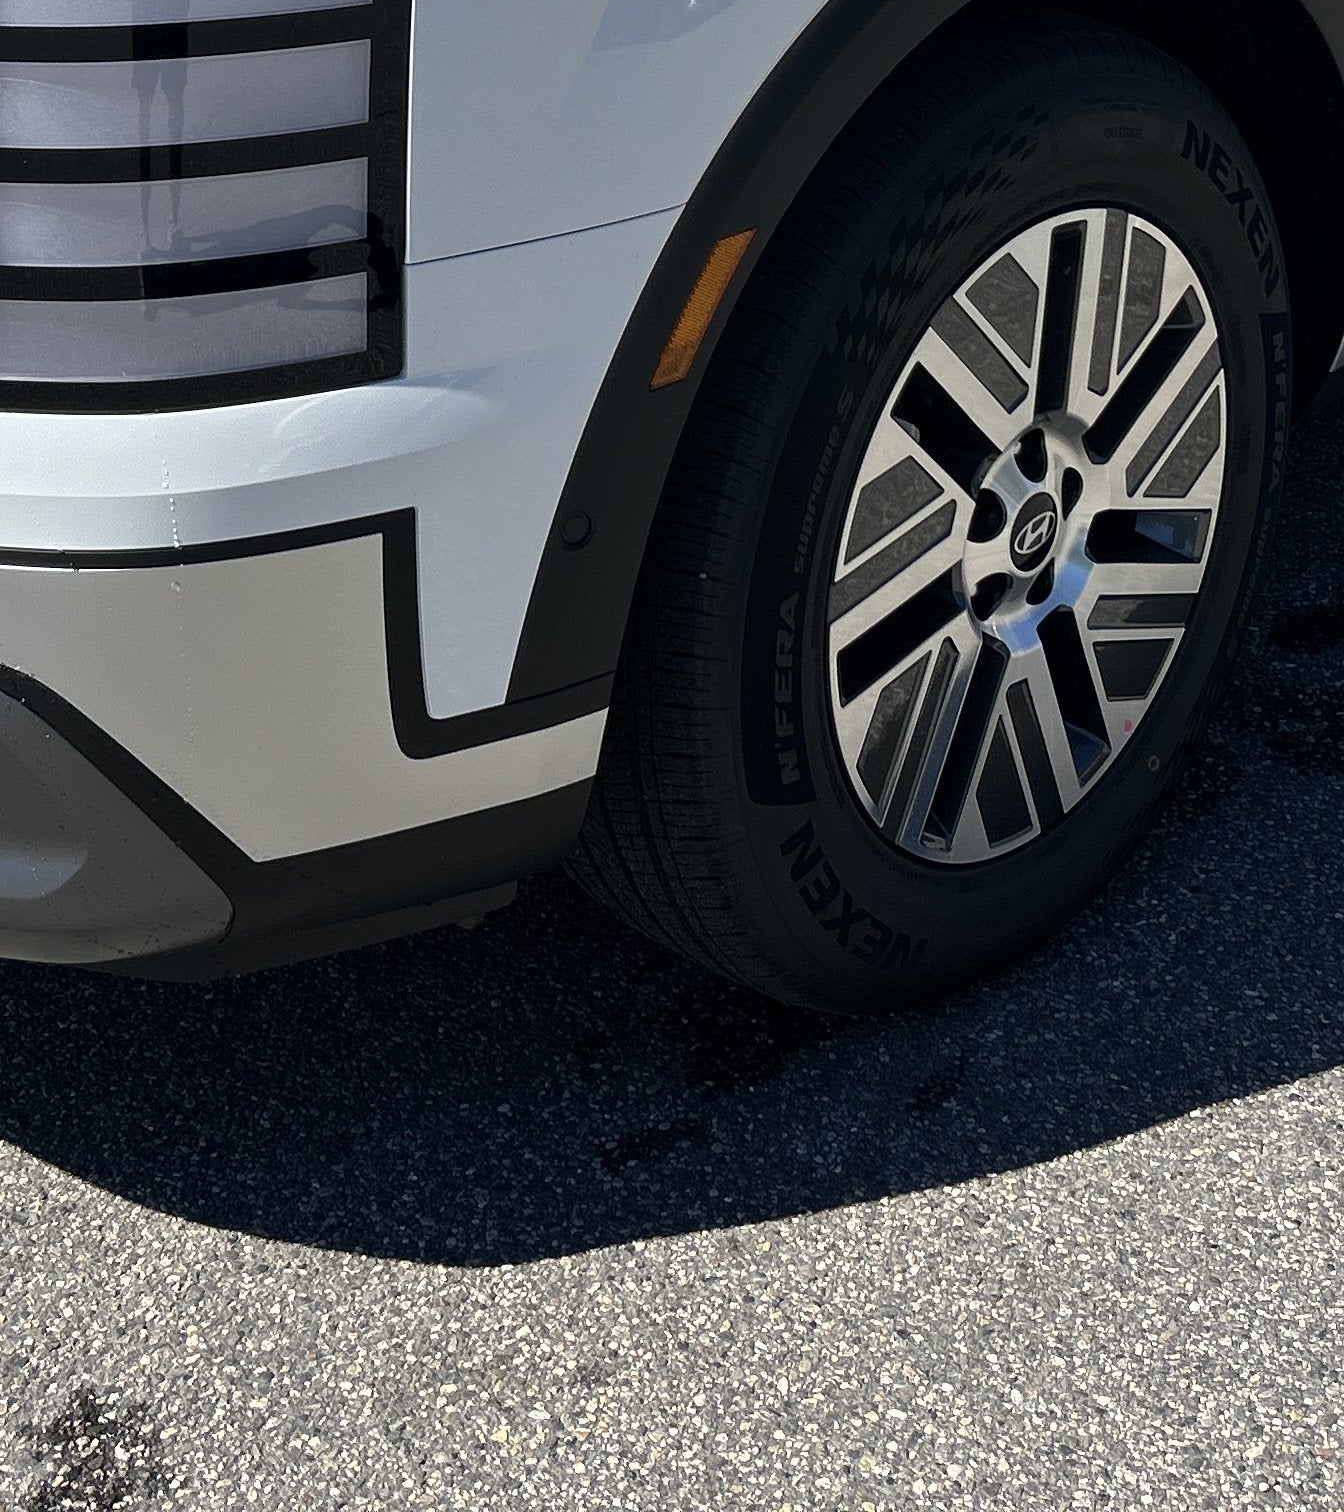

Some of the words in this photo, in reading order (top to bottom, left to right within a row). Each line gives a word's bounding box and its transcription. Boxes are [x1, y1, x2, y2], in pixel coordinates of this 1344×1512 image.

[1181, 120, 1280, 298] NEXEN
[774, 590, 800, 786] N'FERA
[779, 818, 928, 968] NEXEN
